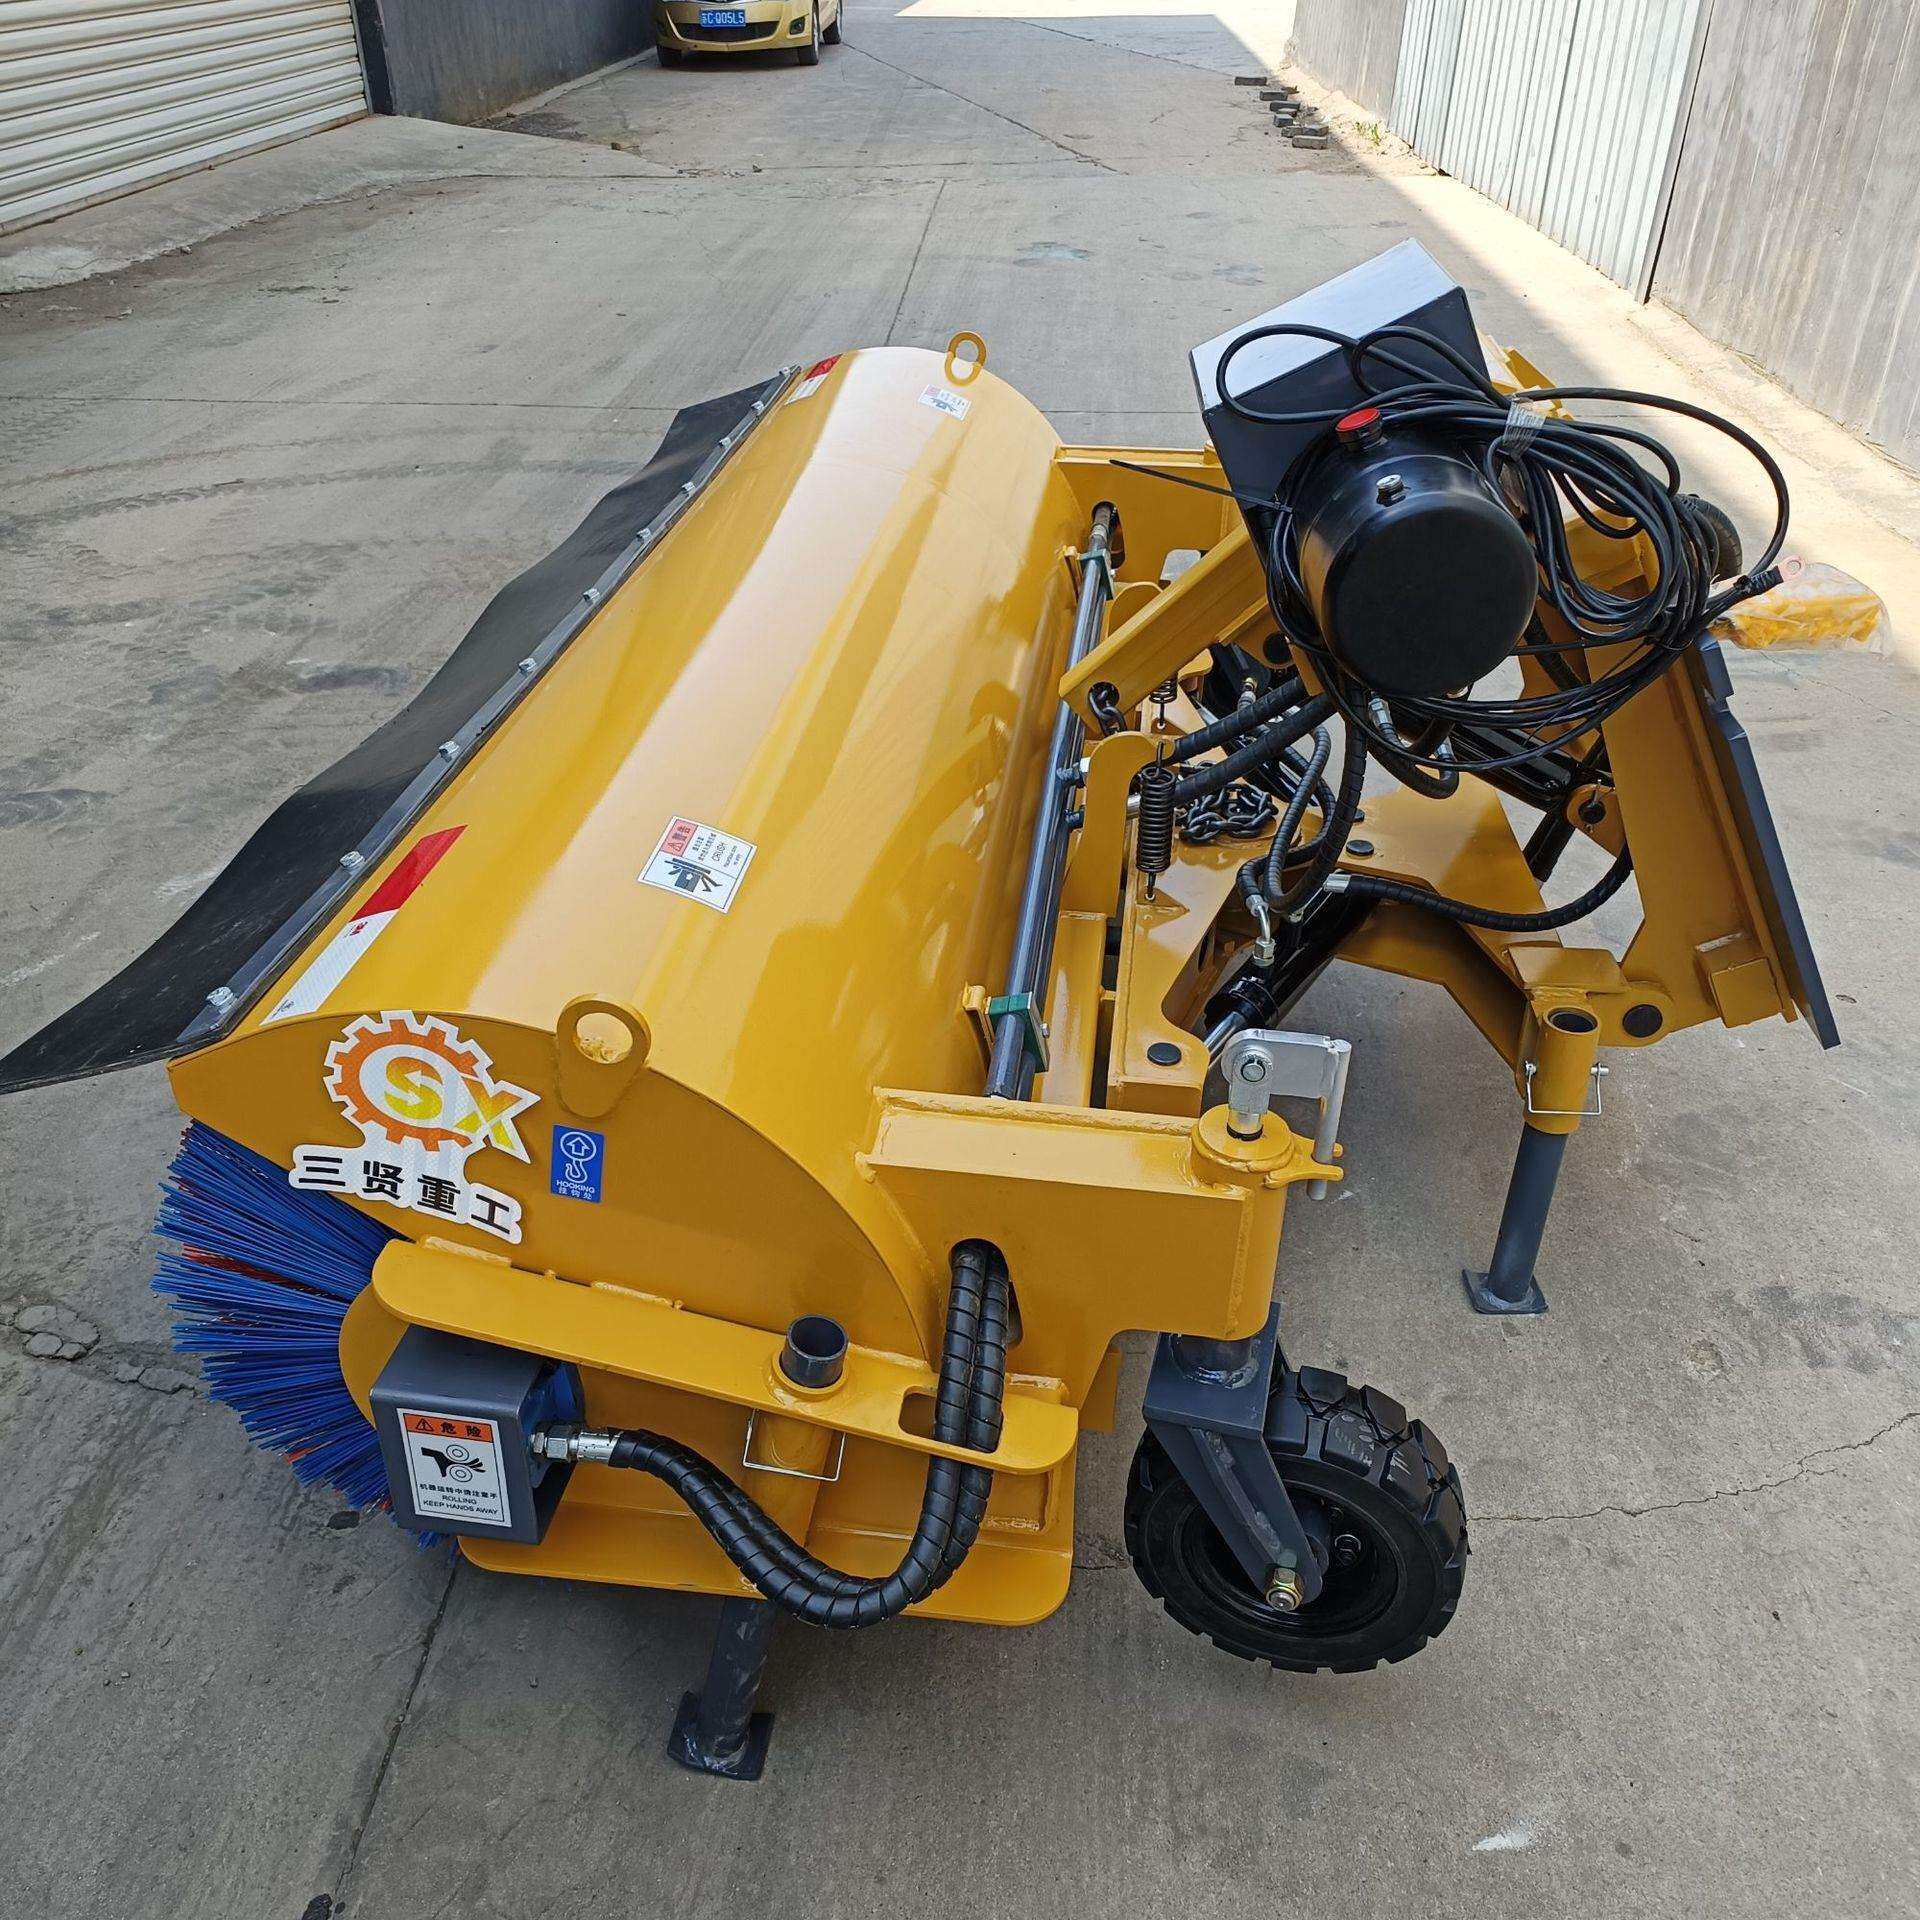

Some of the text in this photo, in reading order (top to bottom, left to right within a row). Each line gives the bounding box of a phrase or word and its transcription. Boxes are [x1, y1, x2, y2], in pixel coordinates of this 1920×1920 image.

[299, 1155, 513, 1234] 三贤重工
[556, 1180, 595, 1194] HOOKING
[440, 1421, 482, 1438] 危险
[446, 1502, 475, 1512] HANDS
